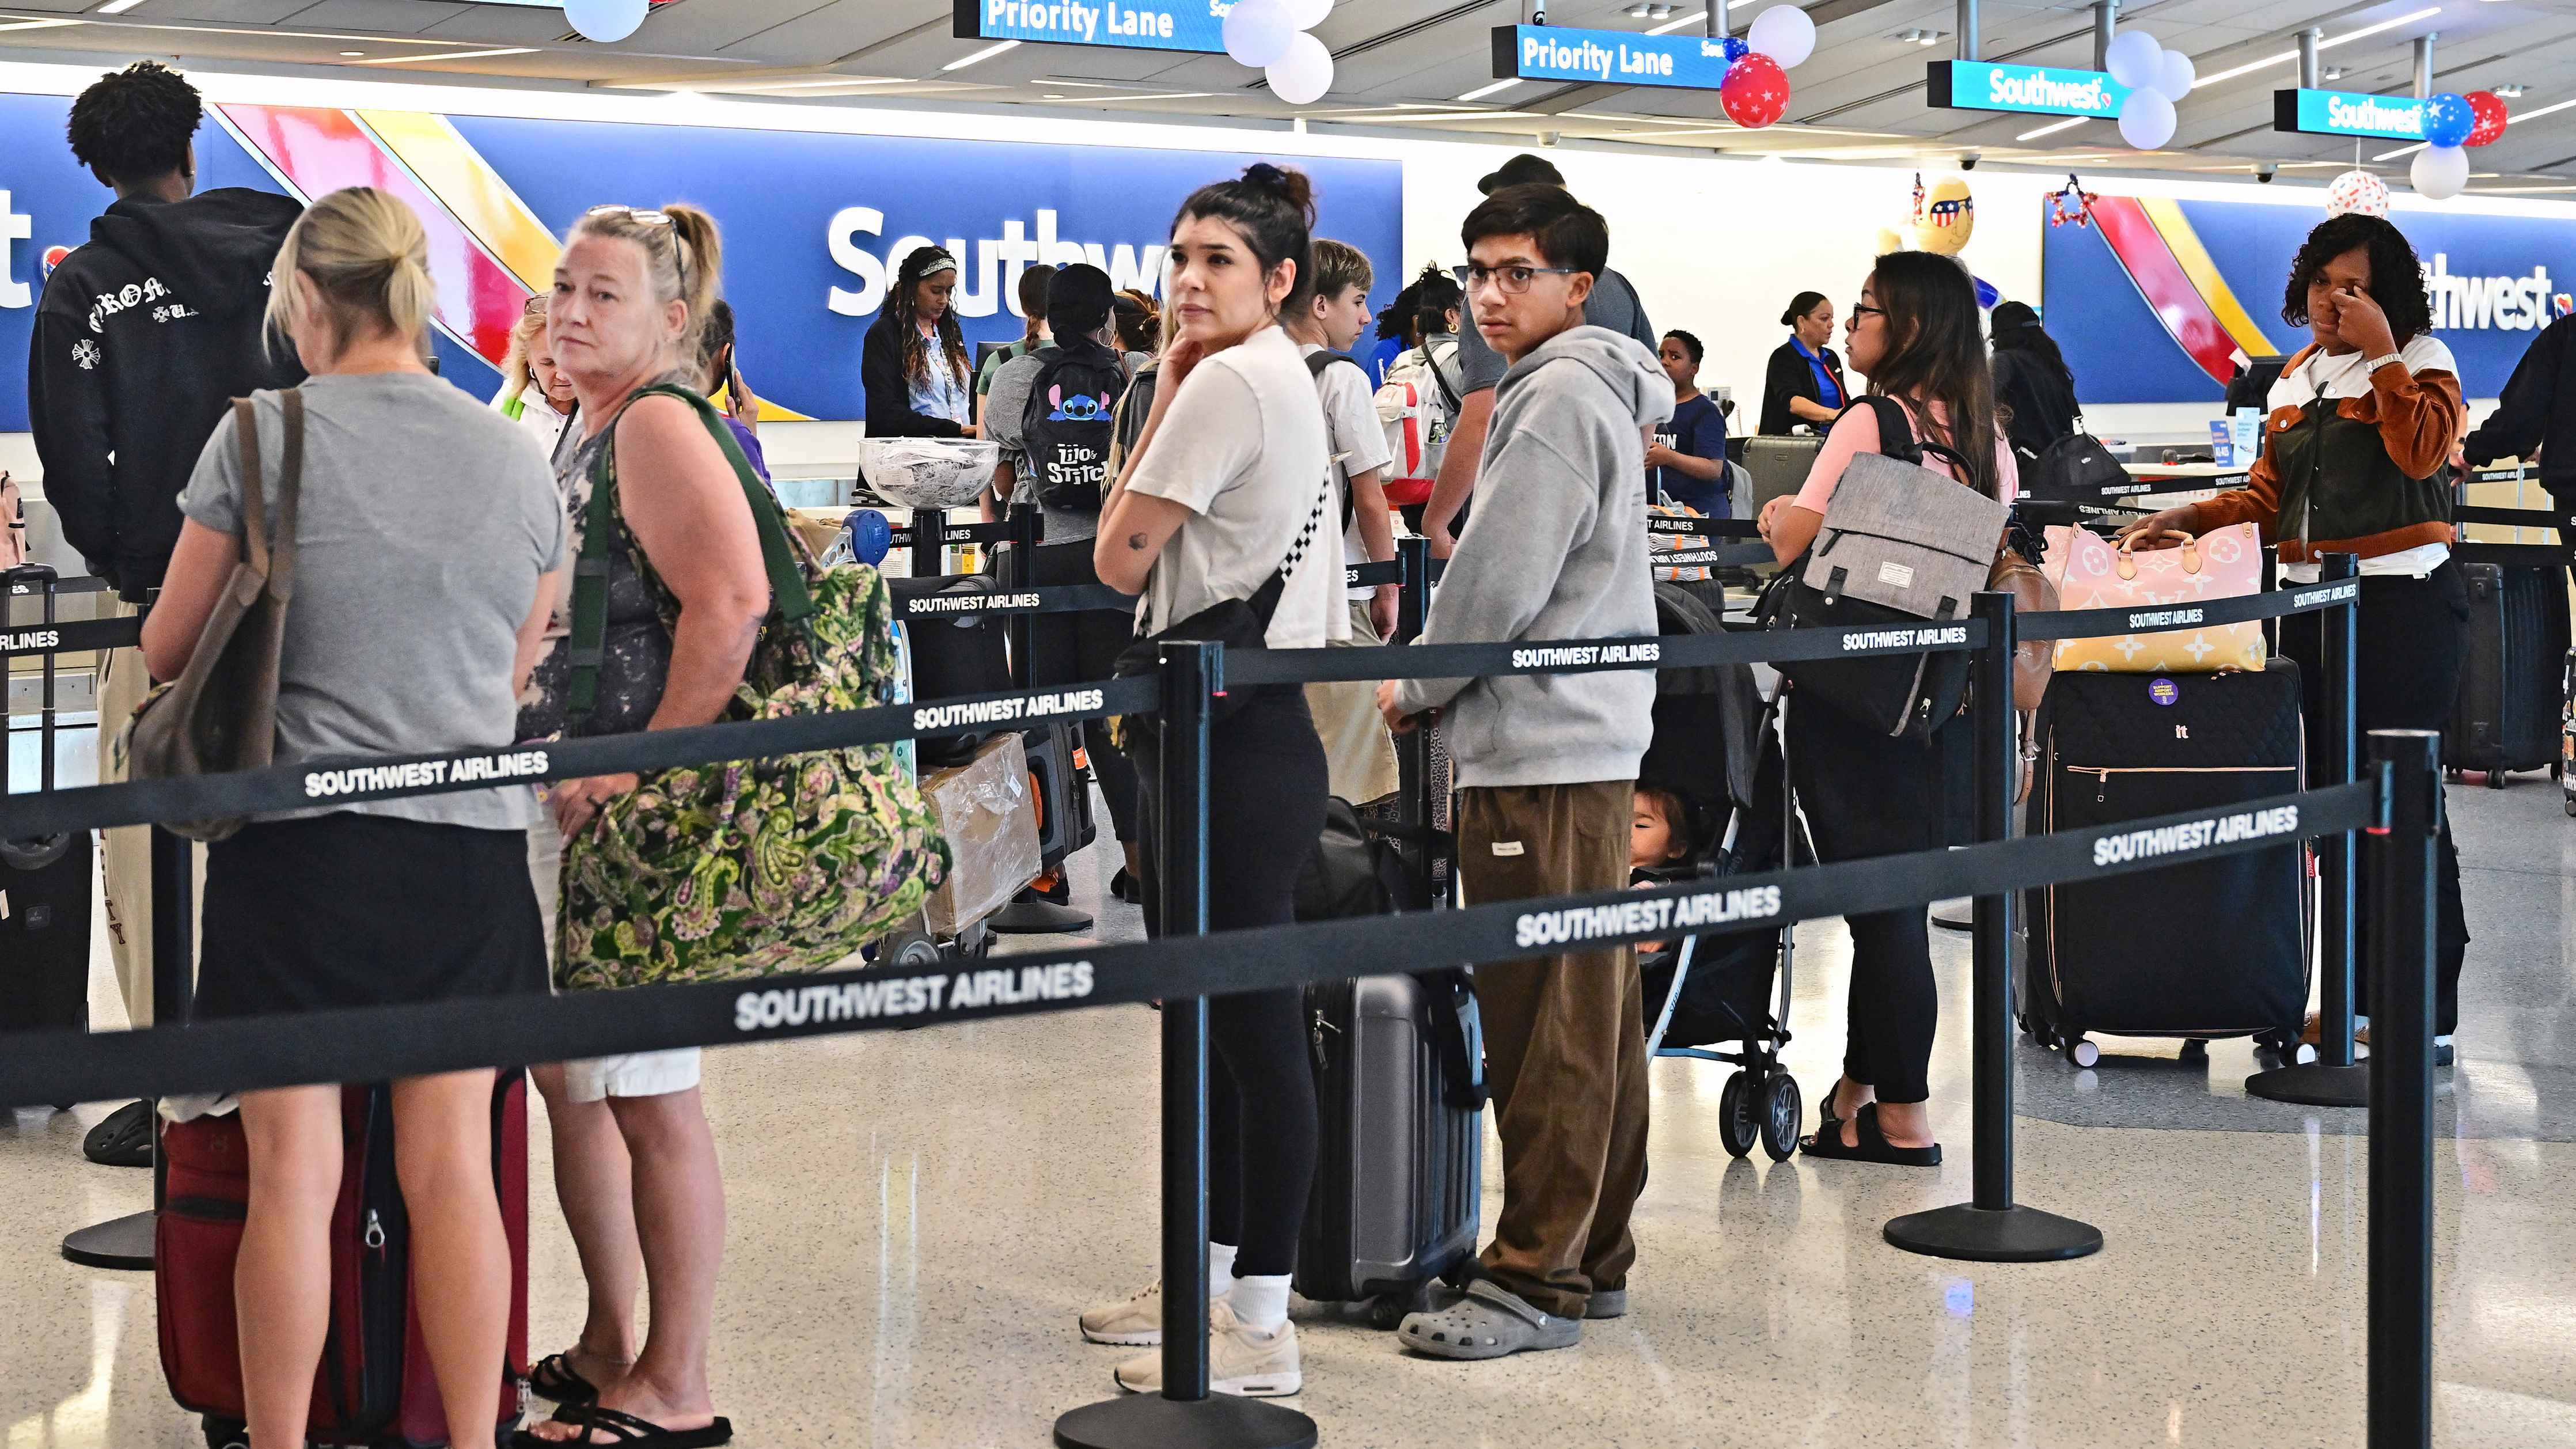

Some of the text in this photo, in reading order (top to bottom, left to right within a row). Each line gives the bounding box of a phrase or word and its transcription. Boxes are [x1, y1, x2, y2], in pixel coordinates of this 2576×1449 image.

[987, 0, 1099, 41] Priority
[1107, 1, 1174, 37] Lane
[1523, 37, 1613, 79] Priority
[1619, 44, 1674, 76] Lane
[1989, 68, 2102, 110] Southwest
[2328, 96, 2422, 134] Southwest
[2419, 253, 2552, 331] thwest
[2101, 484, 2151, 495] SOUTHWEST AIRLINES
[2215, 477, 2243, 485] SOUTHWEST
[945, 529, 971, 541] LINES
[1654, 520, 1694, 531] AIRLINES
[1669, 550, 1718, 563] SOUTHWEST
[909, 593, 1039, 613] SOUTHWEST AIRLINES
[2294, 583, 2357, 608] SOUTHWEST AIRLINES
[2129, 608, 2203, 628] SOUTHWEST AIRLINES
[0, 630, 59, 651] RLINES
[1843, 627, 1967, 651] SOUTHWEST AIRLINES
[1512, 643, 1660, 668] SOUTHWEST AIRLINES
[913, 689, 1103, 730] SOUTHWEST AIRLINES
[2176, 724, 2188, 739] it
[305, 750, 549, 798] SOUTHWEST AIRLINES
[2093, 805, 2299, 866] SOUTHWEST AIRLINES
[1515, 885, 1781, 947] SOUTHWEST AIRLINES
[734, 961, 1094, 1031] SOUTHWEST AIRLINES
